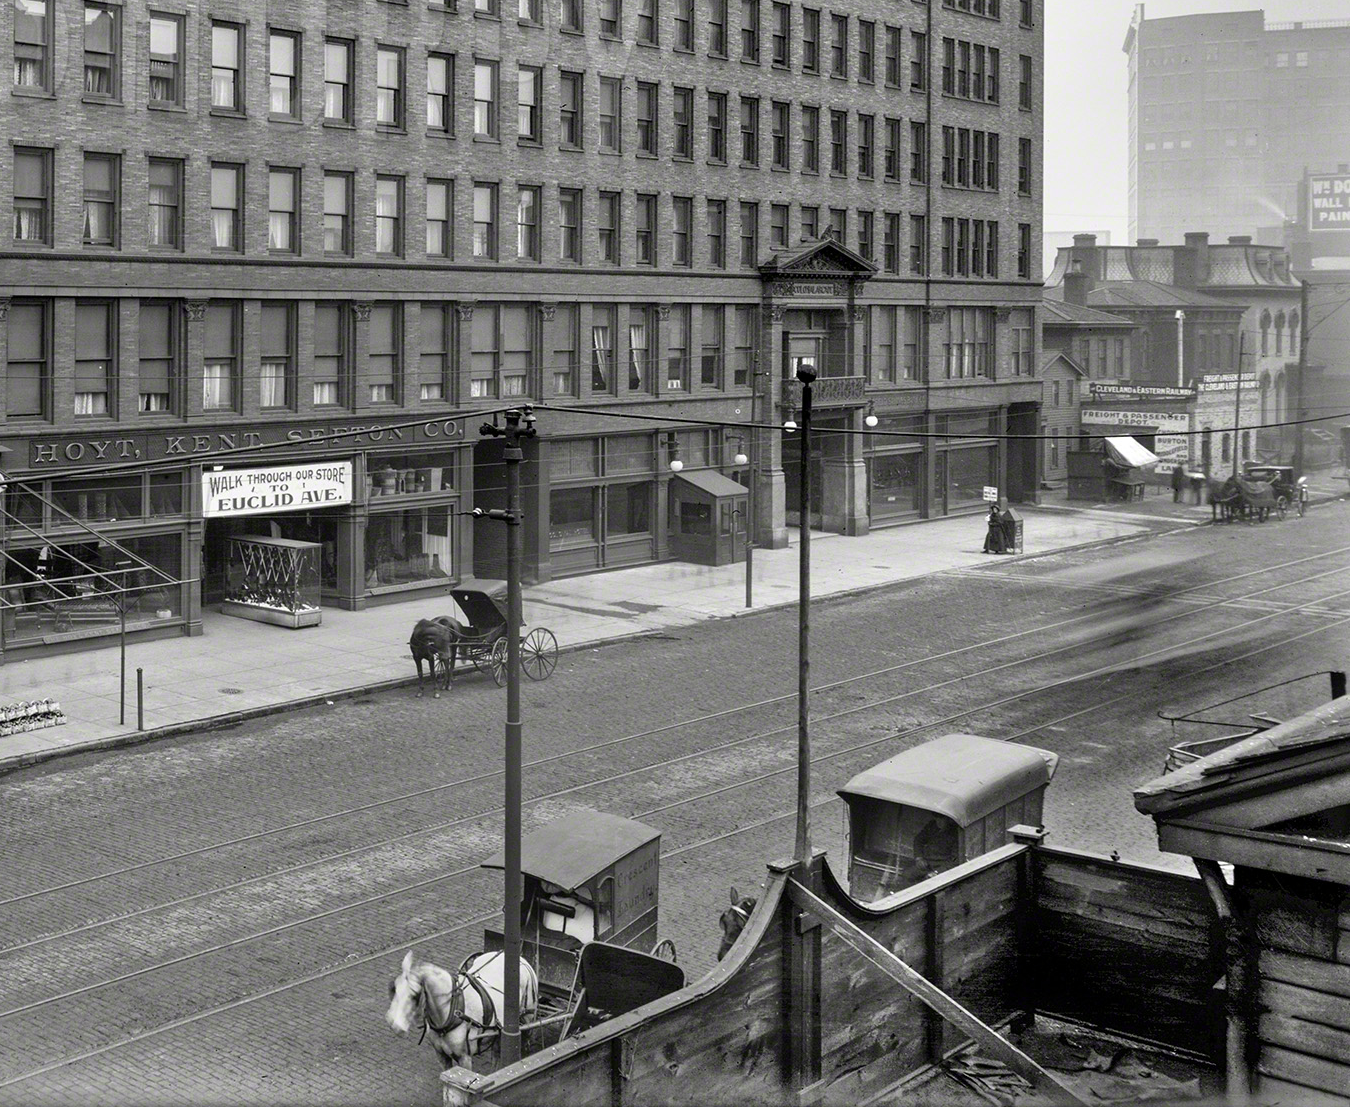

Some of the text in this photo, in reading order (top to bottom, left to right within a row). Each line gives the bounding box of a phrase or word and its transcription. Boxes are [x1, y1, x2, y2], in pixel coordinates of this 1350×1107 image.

[1313, 197, 1343, 208] WALL
[1095, 385, 1132, 394] CLEVELAND
[1137, 386, 1165, 395] EASTERN
[1165, 387, 1192, 396] RAILWAY
[35, 439, 140, 463] HOYT,
[286, 425, 402, 445] SEFTON
[209, 466, 345, 497] WALK THROUGH OUR STORE
[269, 484, 289, 492] TO
[218, 488, 343, 512] EUCLID AVE.
